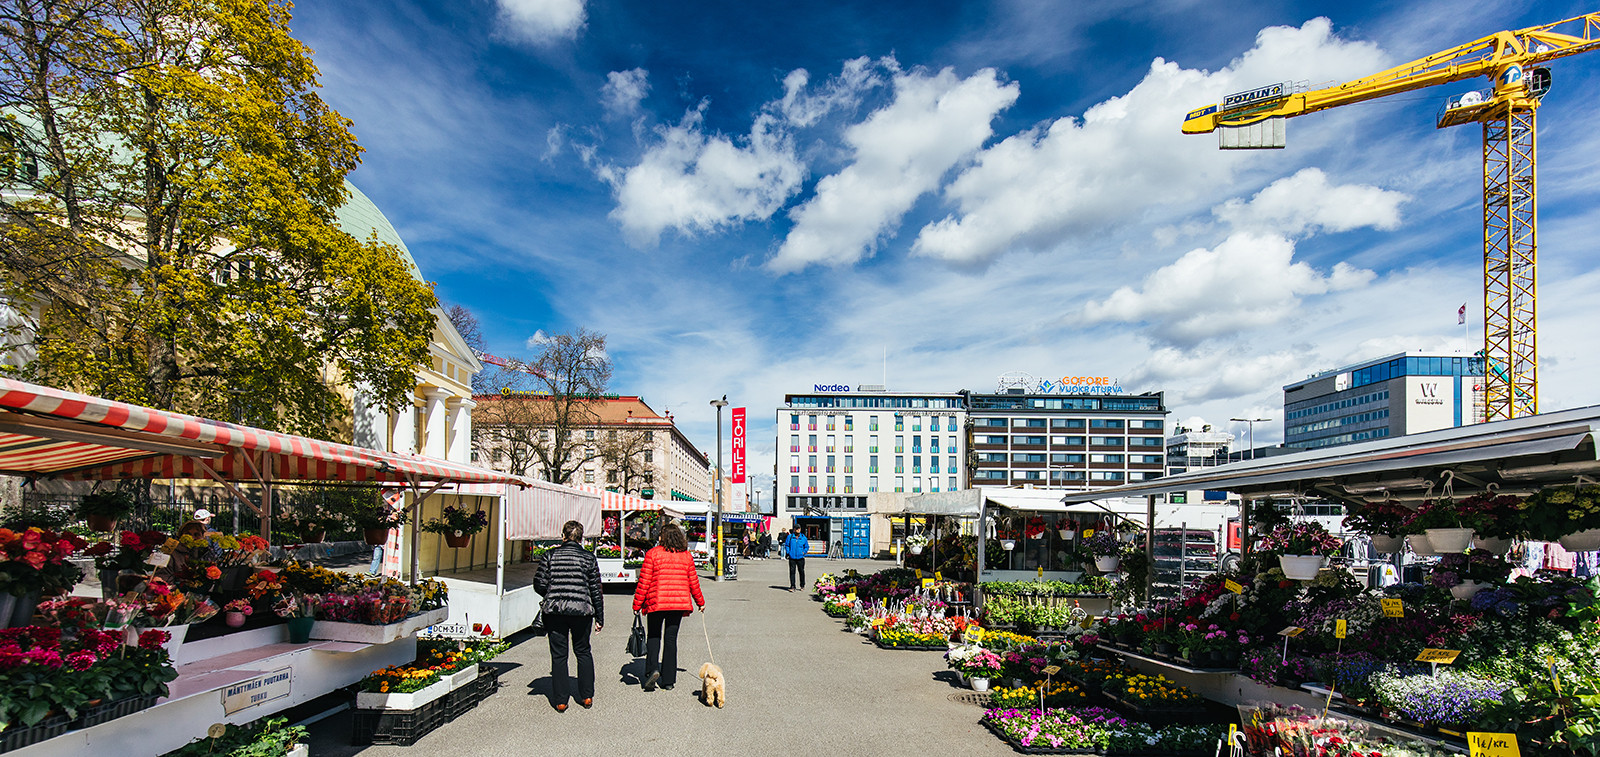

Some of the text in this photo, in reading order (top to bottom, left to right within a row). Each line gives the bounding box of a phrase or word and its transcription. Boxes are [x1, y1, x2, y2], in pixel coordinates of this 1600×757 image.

[1225, 87, 1271, 106] POTAIN
[1062, 376, 1109, 385] GOFORE
[814, 383, 850, 392] Nordea
[1059, 385, 1123, 393] VUOKRATURVA
[1420, 382, 1438, 398] W
[433, 625, 464, 634] DCM-312
[227, 672, 289, 697] MÄNTYMÄEN PUUTARHA
[250, 691, 268, 704] TURKU
